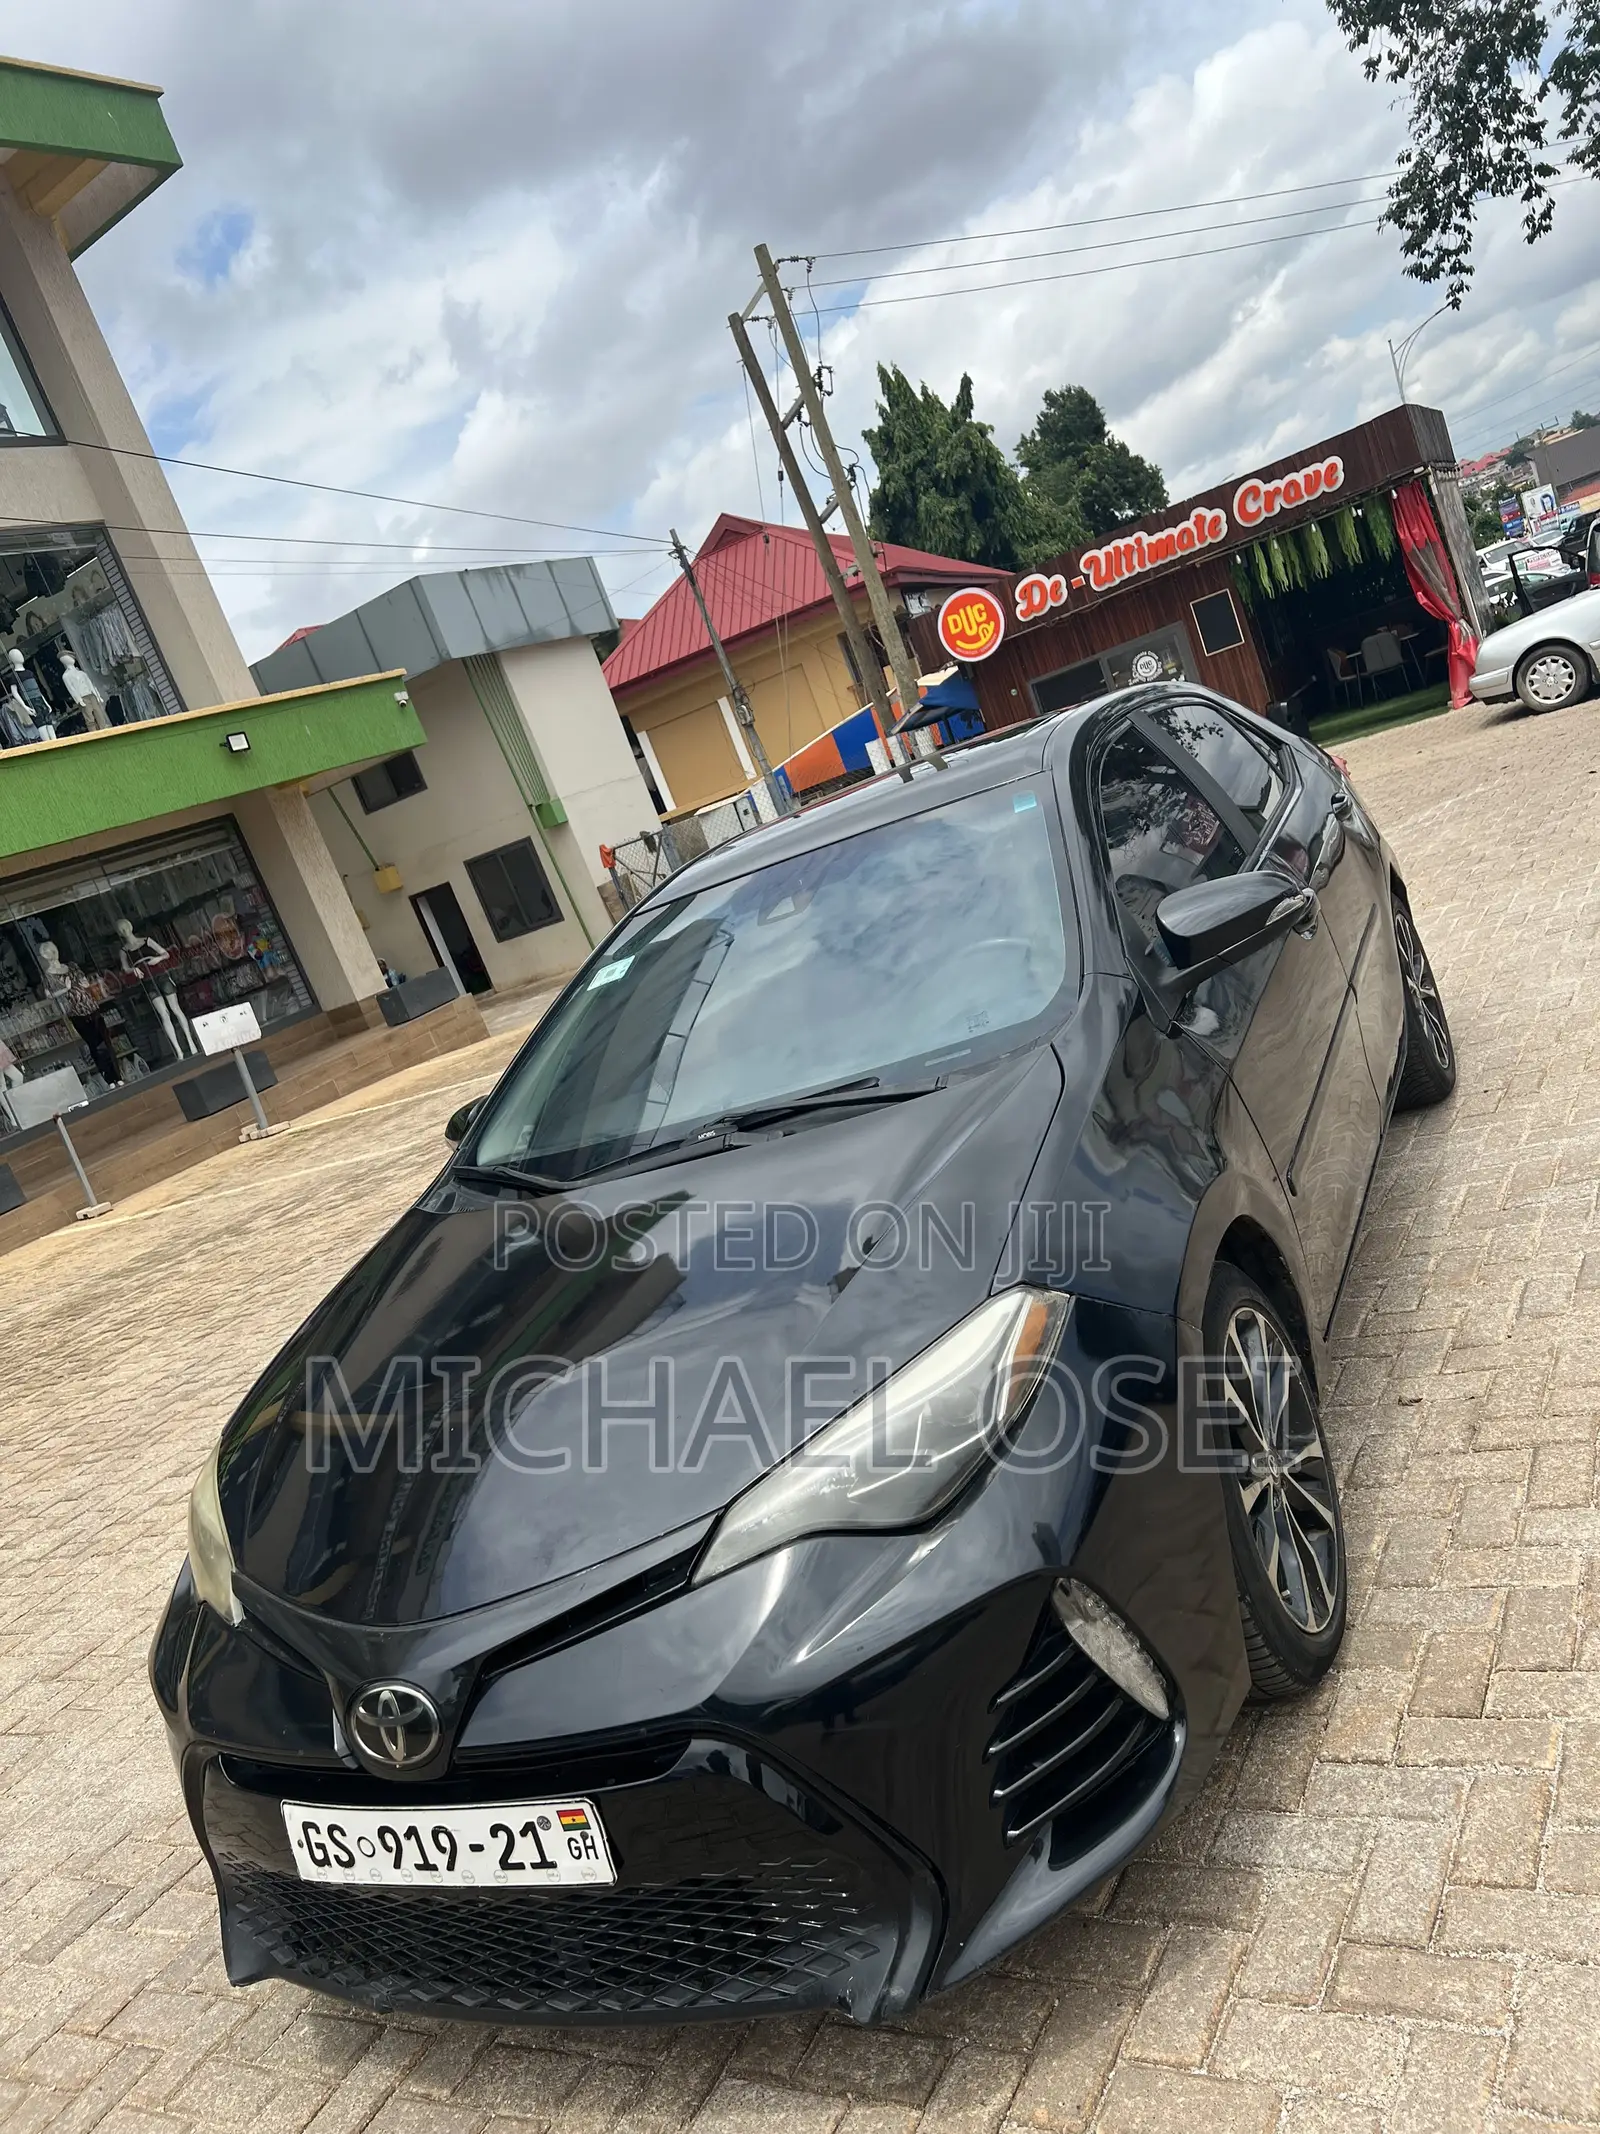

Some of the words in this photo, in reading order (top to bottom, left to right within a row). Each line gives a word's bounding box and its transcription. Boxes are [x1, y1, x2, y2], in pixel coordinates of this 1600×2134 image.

[1017, 576, 1065, 620] De
[1082, 510, 1224, 588] Ultimate
[1235, 458, 1341, 525] Crave
[301, 1821, 356, 1868] GS
[377, 1820, 558, 1871] 919-21
[567, 1833, 599, 1860] GH
